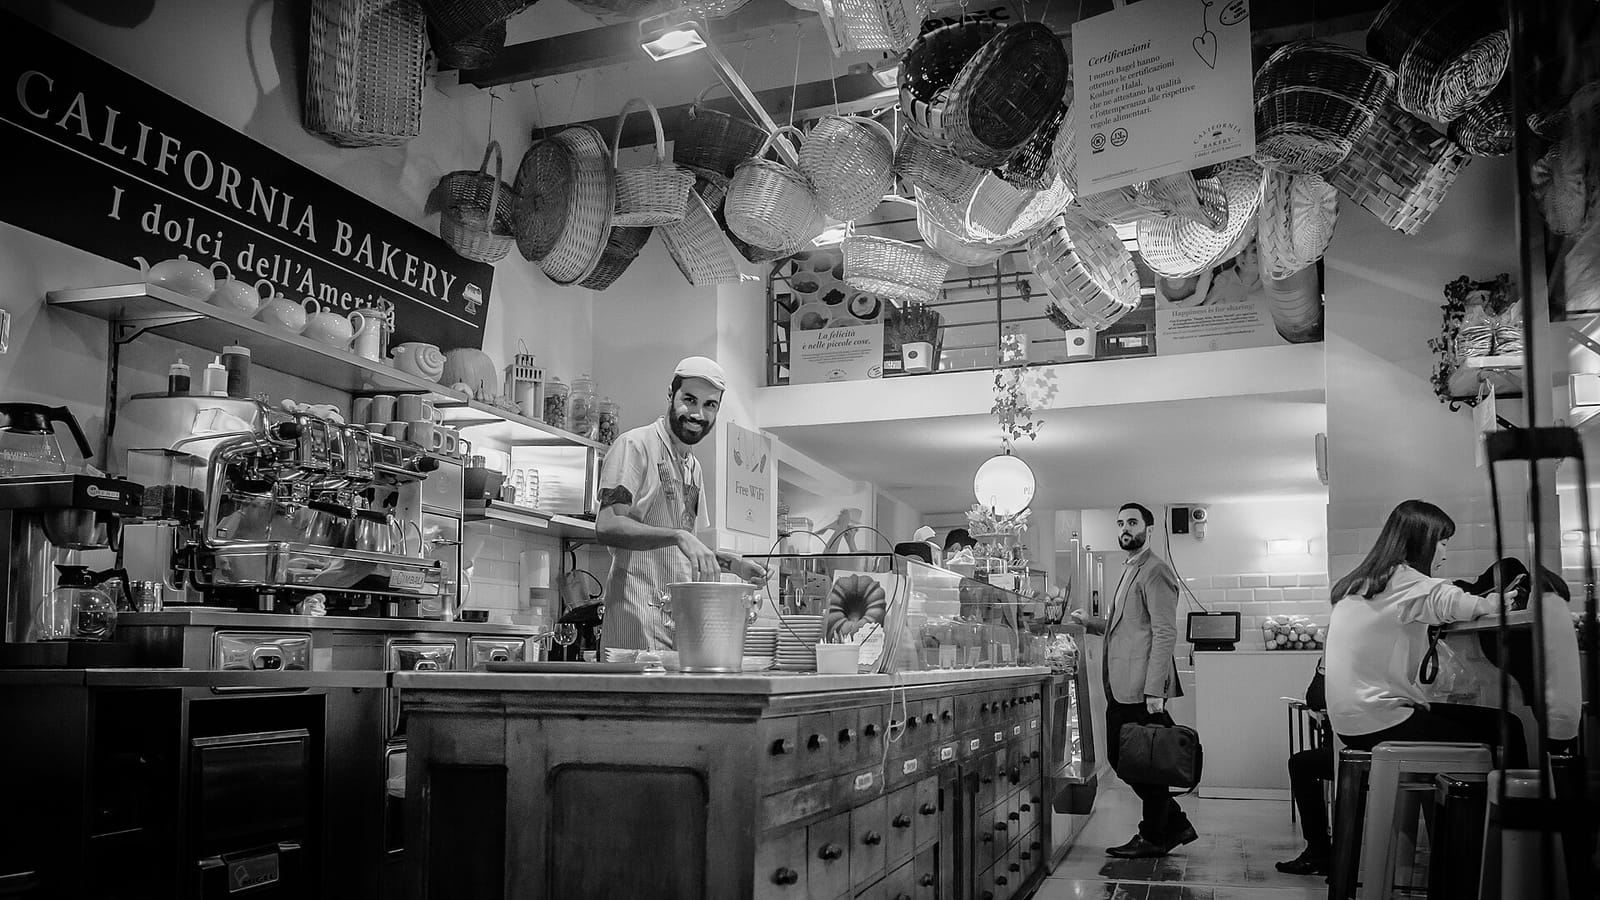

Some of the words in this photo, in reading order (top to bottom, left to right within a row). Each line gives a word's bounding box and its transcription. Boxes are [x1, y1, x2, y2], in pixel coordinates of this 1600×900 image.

[1088, 39, 1151, 67] Certificazioni
[1088, 78, 1119, 91] ottenuto
[1120, 74, 1127, 82] le
[1127, 59, 1175, 80] certificazioni
[1094, 69, 1114, 81] nostri
[1116, 62, 1136, 74] Bagel
[1137, 55, 1160, 68] hanno
[1089, 101, 1101, 111] che
[1103, 98, 1112, 107] ne
[1113, 89, 1146, 103] attestano
[1147, 85, 1154, 93] la
[1155, 77, 1182, 92] qualità
[1089, 88, 1114, 101] Kosher
[1095, 98, 1146, 119] l'ottemperanza
[1147, 92, 1160, 103] alle
[1161, 84, 1196, 100] rispettive
[1090, 117, 1112, 130] regole
[1112, 106, 1152, 123] alimentari.
[1193, 122, 1241, 145] CALIFORNIA
[16, 70, 316, 244] CALIFORNIA
[332, 220, 457, 303] BAKERY
[108, 186, 125, 221] I
[141, 204, 224, 260] dolci
[1172, 309, 1207, 318] Happiness
[1215, 305, 1226, 313] for
[802, 342, 807, 350] è
[808, 340, 825, 350] nelle
[827, 338, 853, 350] piccole
[818, 332, 828, 340] La
[828, 328, 856, 341] felicità
[735, 480, 749, 497] Free
[749, 484, 765, 502] WiFi
